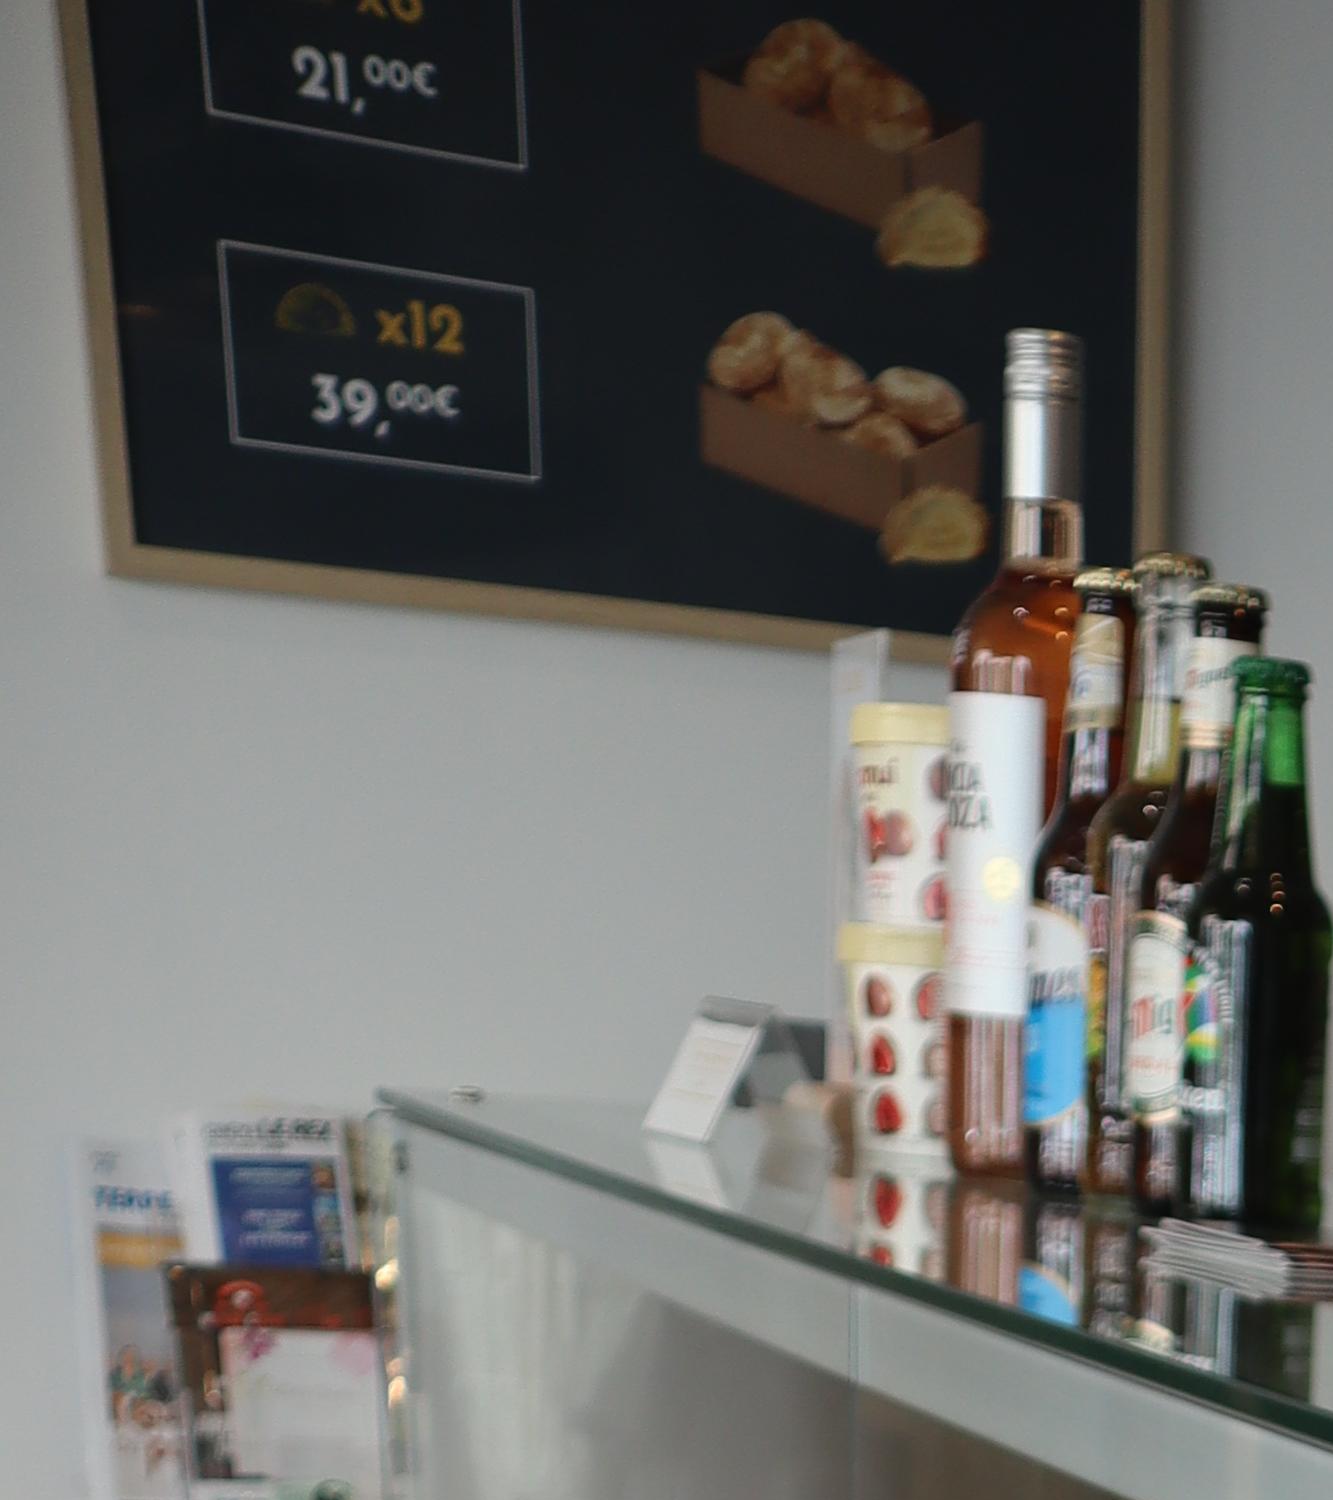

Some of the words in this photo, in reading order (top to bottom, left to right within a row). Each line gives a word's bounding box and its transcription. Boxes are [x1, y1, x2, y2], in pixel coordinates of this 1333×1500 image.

[291, 44, 438, 116] 21,00€
[375, 299, 465, 356] x12
[311, 372, 460, 438] 39,00€
